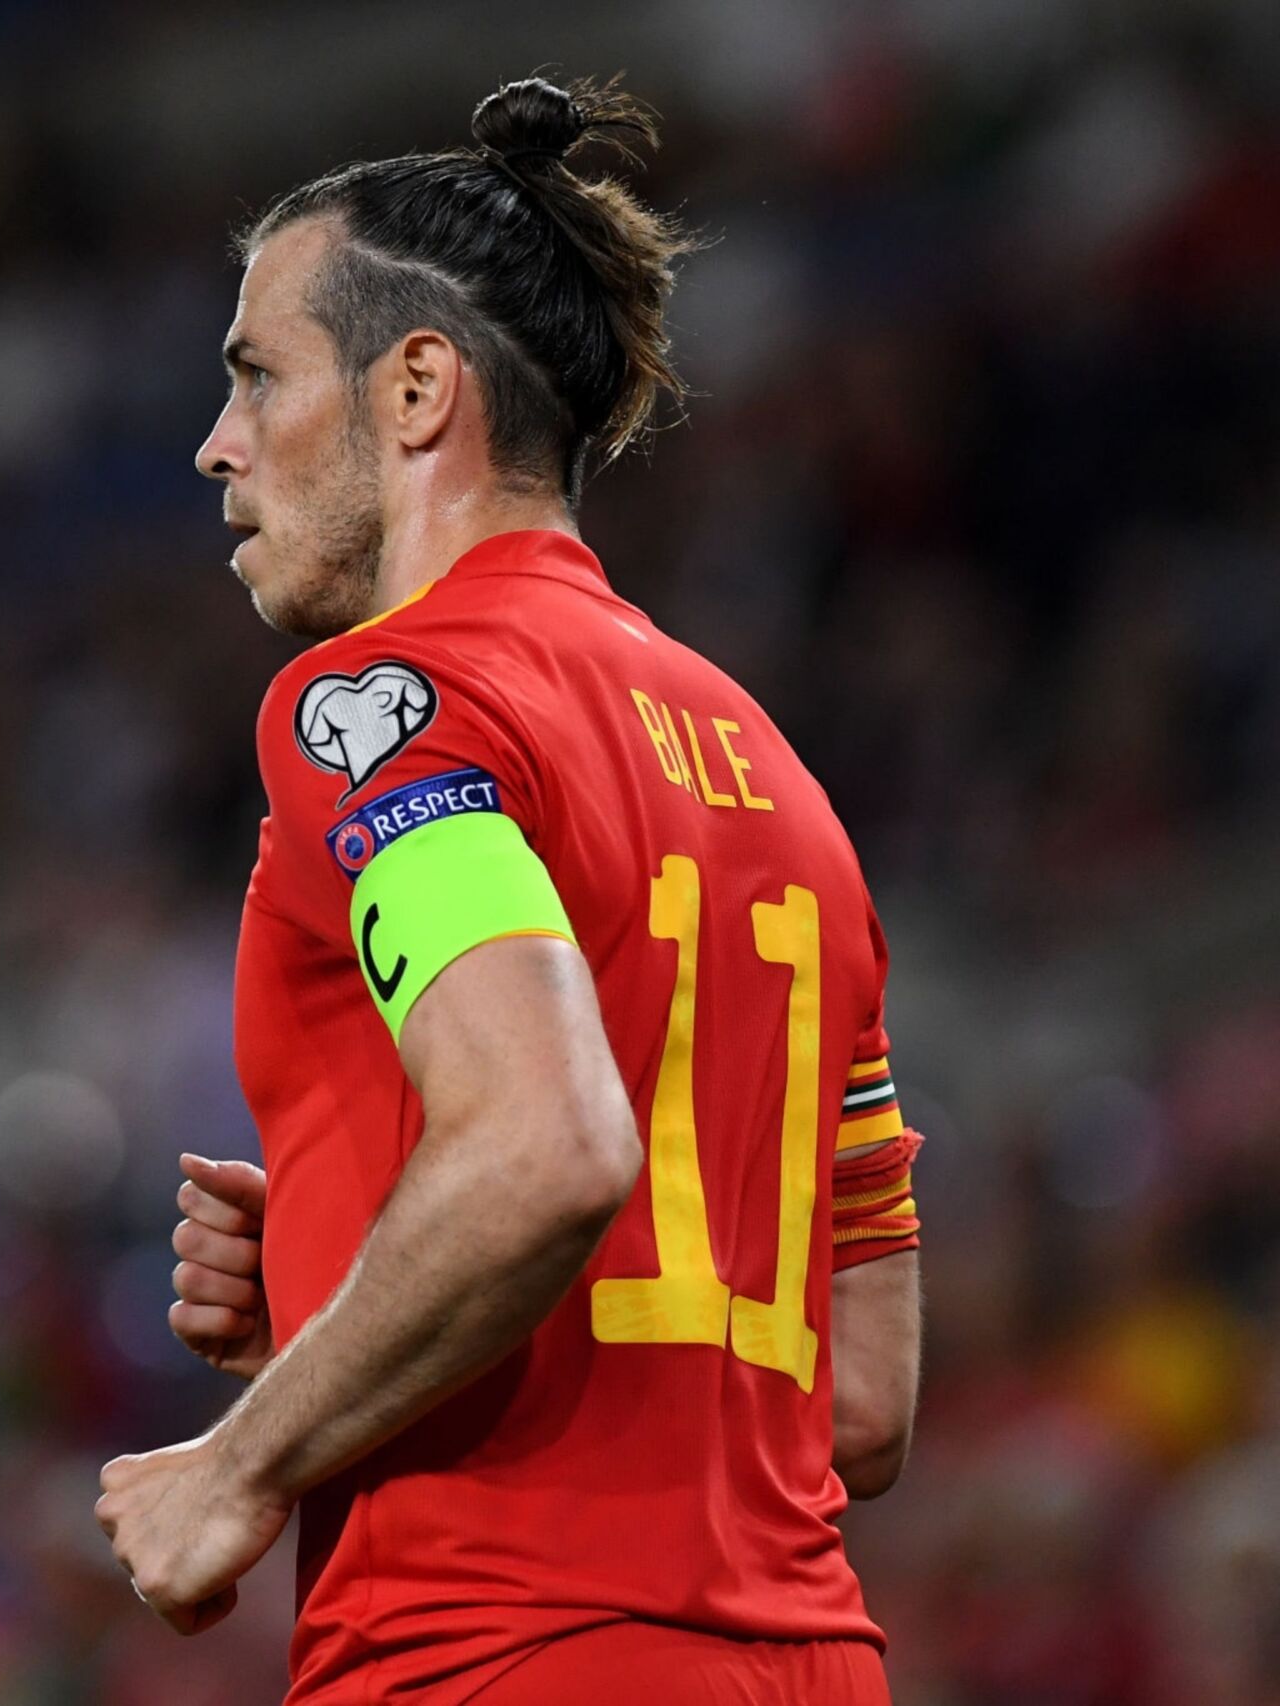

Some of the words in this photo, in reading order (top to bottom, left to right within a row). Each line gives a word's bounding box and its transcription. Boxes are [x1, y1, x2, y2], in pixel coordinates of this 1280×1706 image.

[629, 688, 774, 811] BALE
[372, 782, 493, 840] RESPECT
[362, 902, 408, 1003] C
[591, 854, 818, 1394] 11
